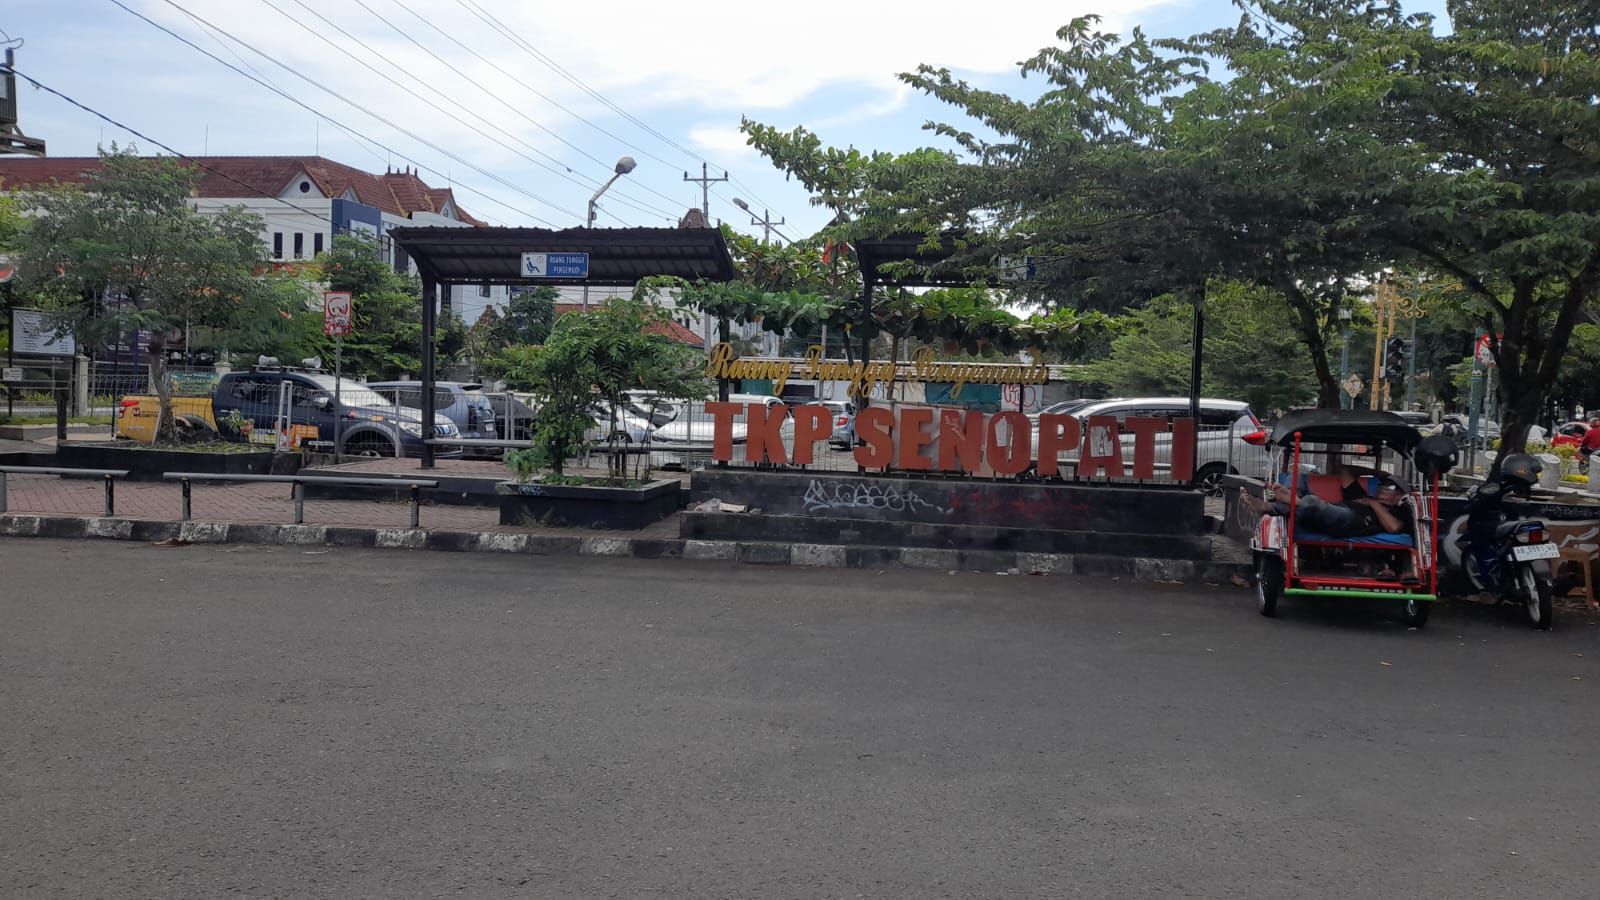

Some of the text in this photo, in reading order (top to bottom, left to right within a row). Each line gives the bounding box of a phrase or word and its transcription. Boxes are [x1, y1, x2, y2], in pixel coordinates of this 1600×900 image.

[704, 341, 793, 396] Ruang
[800, 344, 896, 398] Tunggu
[905, 345, 1049, 399] Pengemudi
[704, 401, 1195, 481] TKP SENOPATI
